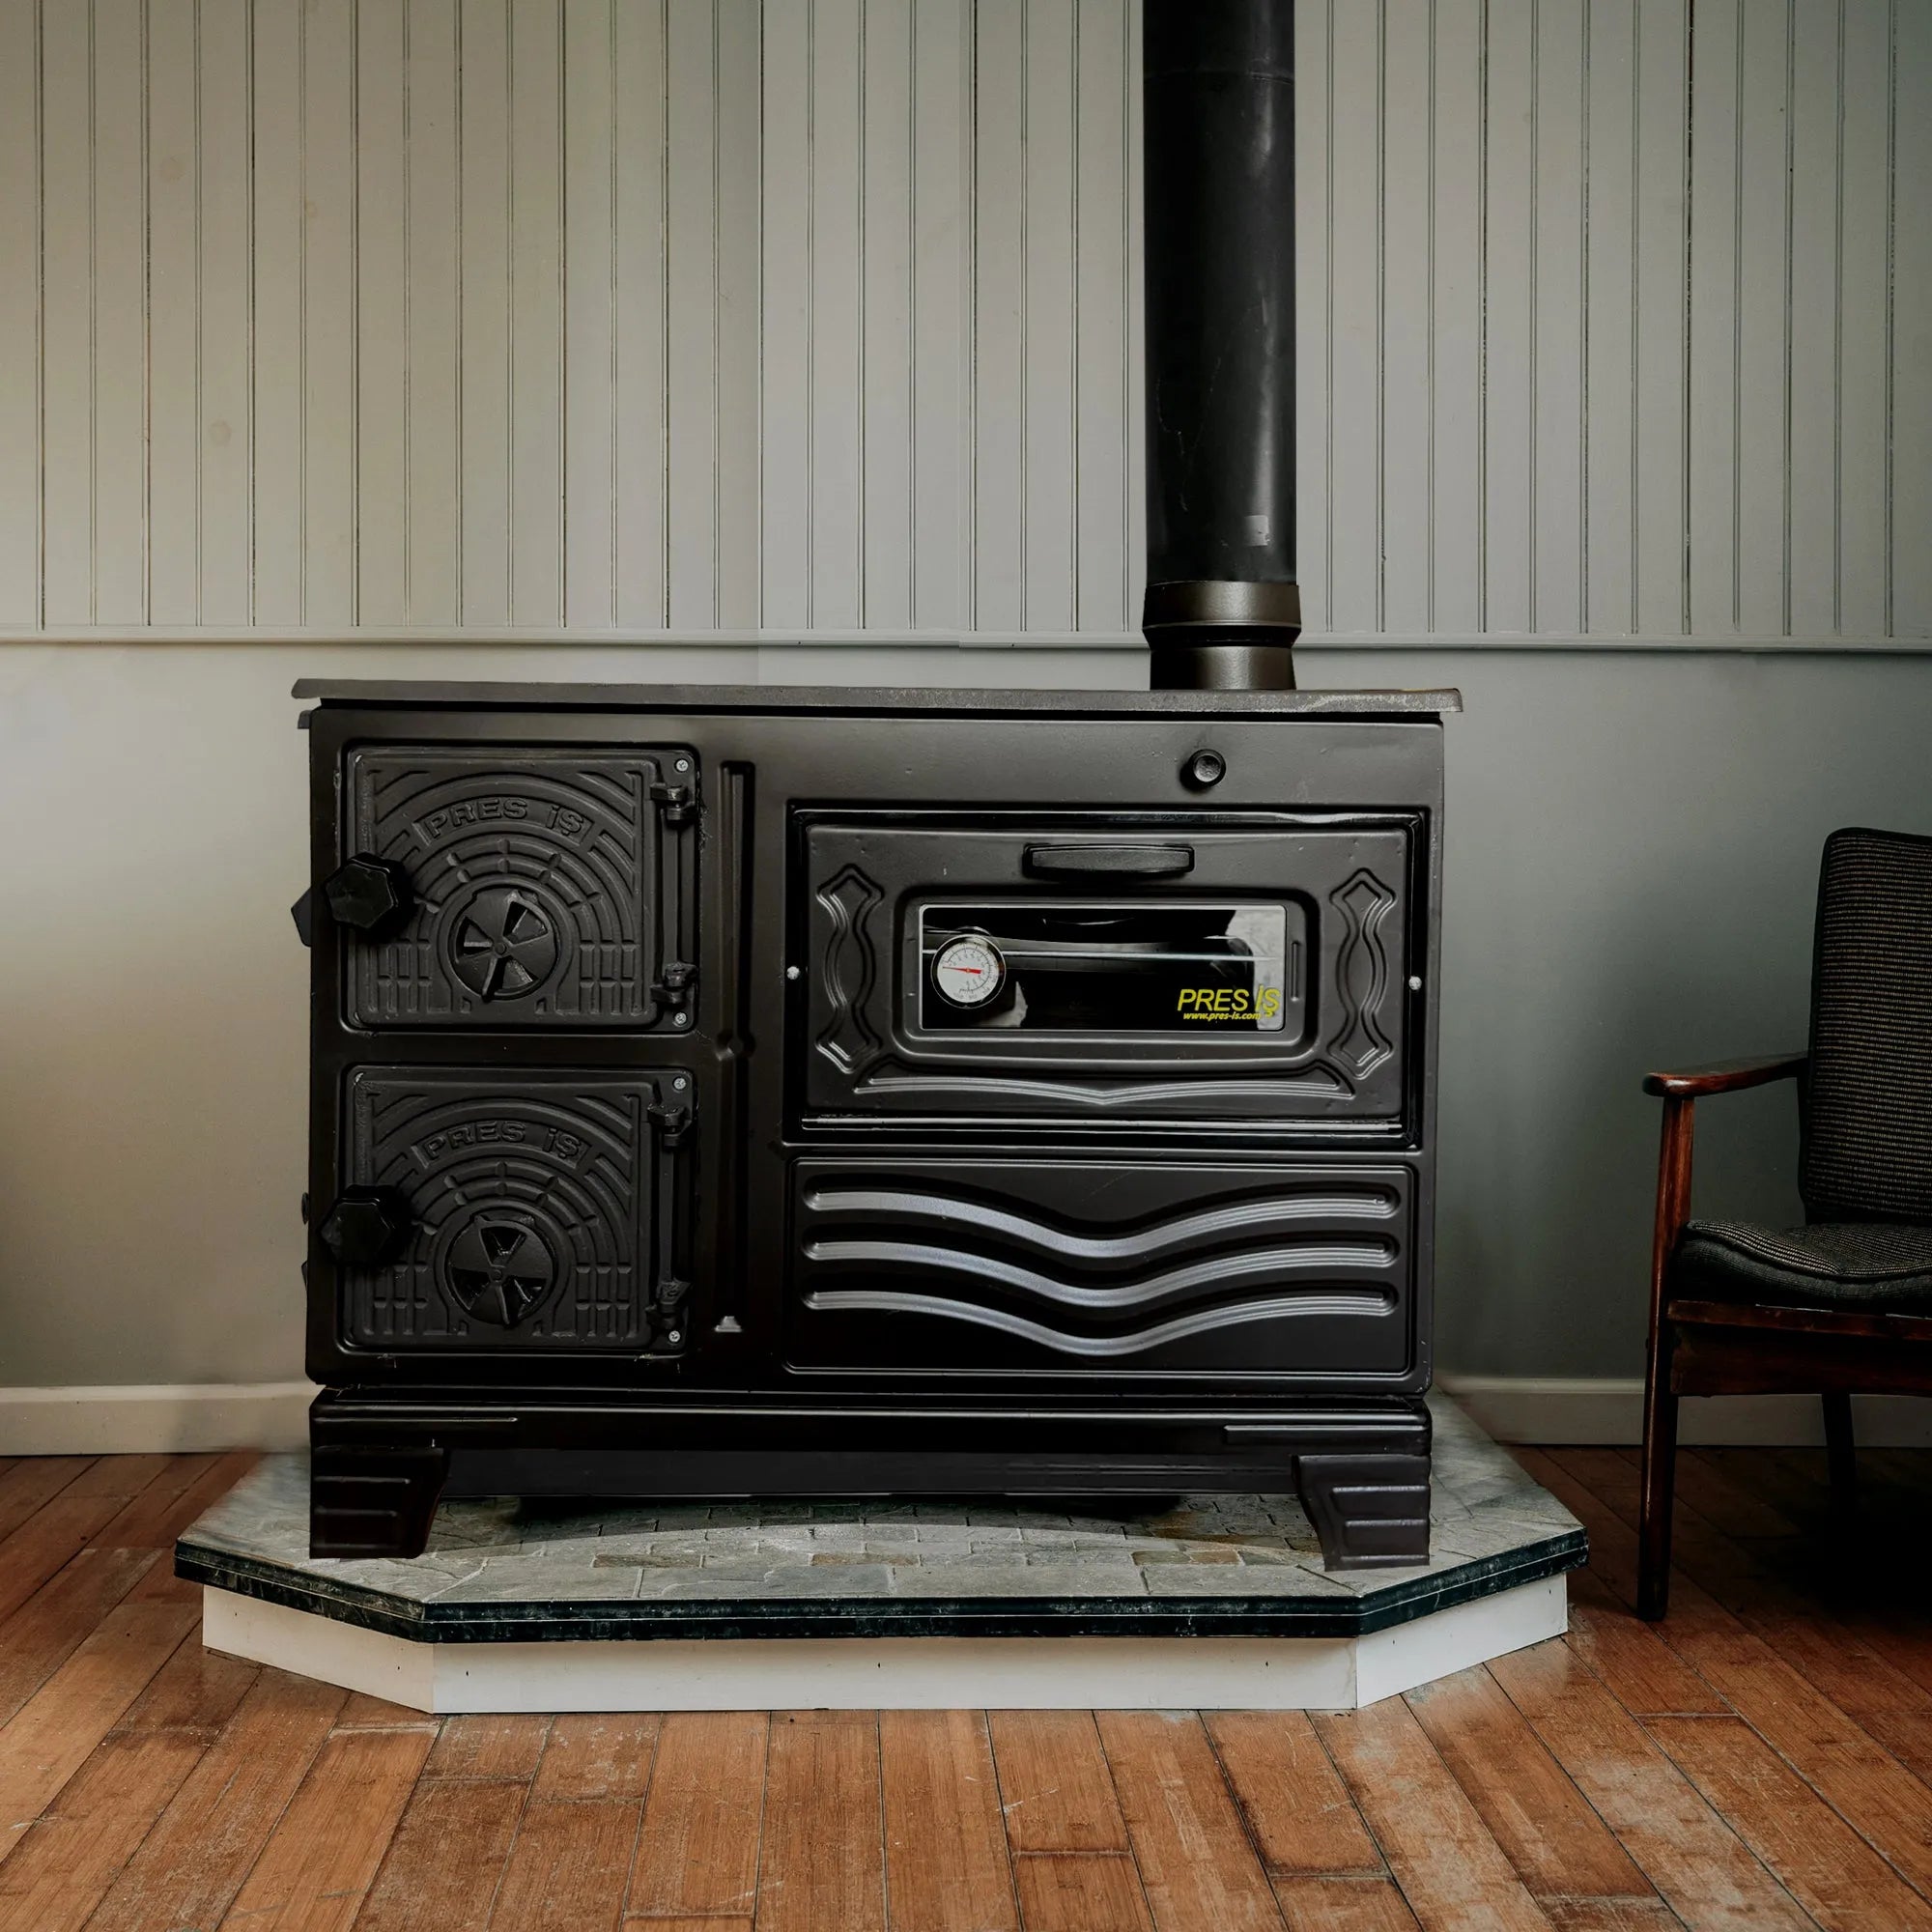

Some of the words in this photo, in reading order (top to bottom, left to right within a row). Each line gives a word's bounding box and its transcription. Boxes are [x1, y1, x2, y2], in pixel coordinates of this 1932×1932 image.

[425, 798, 527, 838] PRES
[1178, 988, 1250, 1010] PRES
[1183, 1011, 1261, 1021] www.pres-is.com
[423, 1121, 526, 1160] PRES
